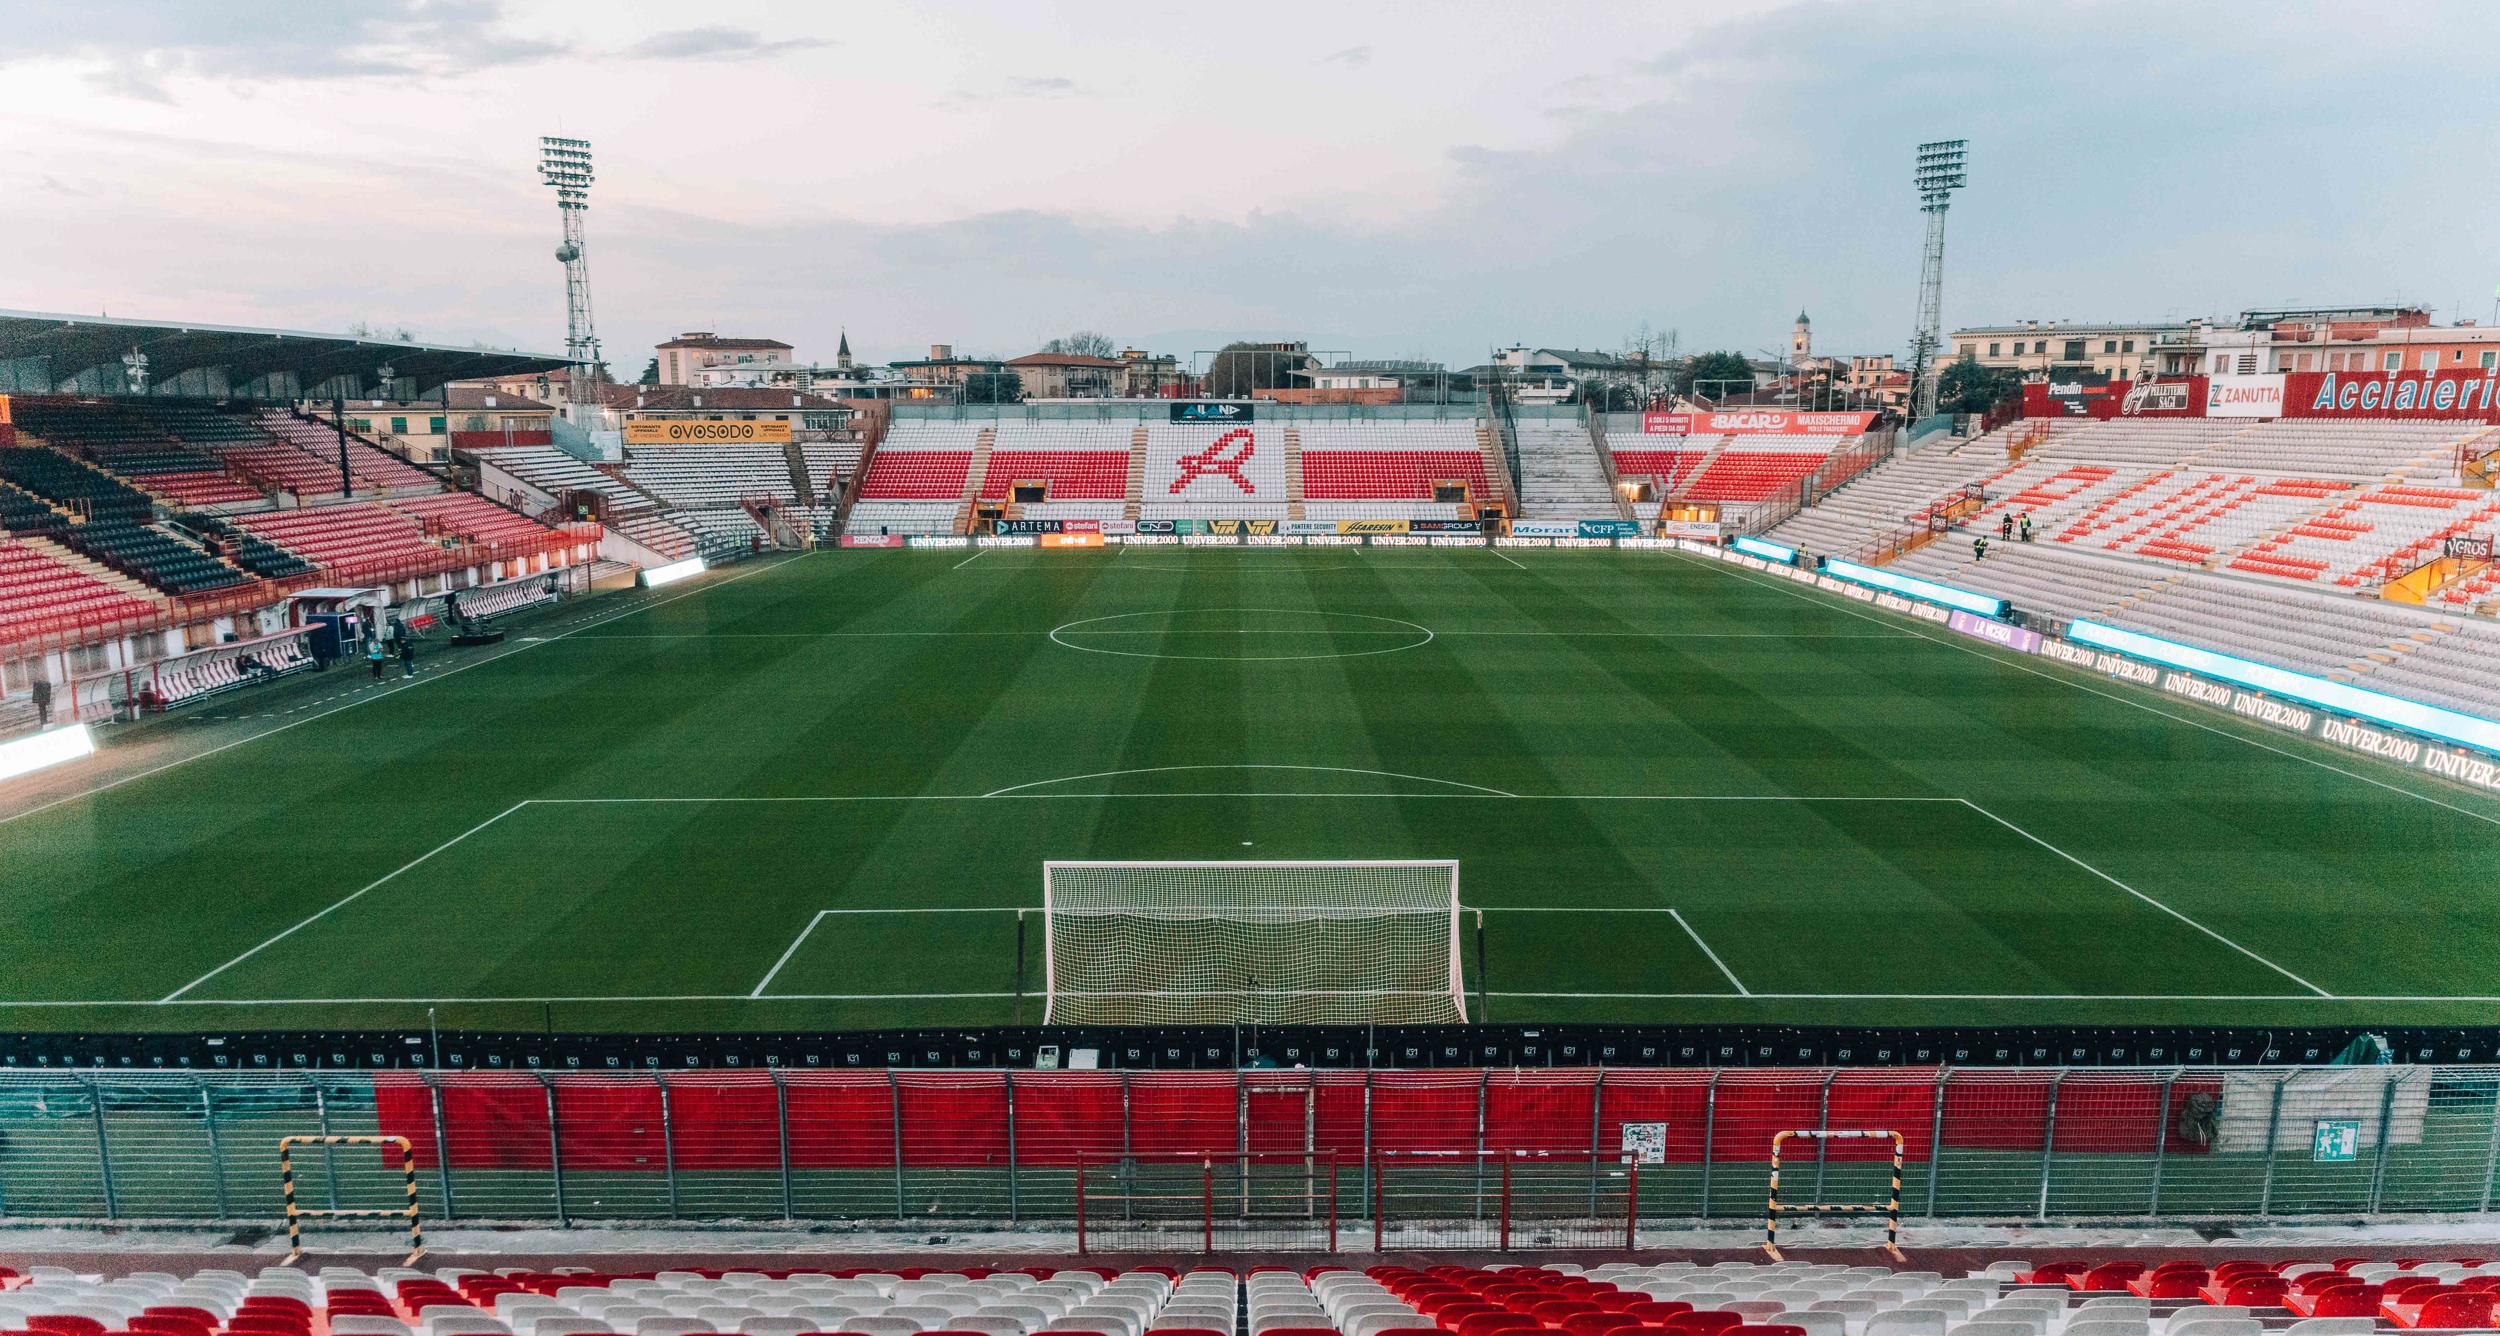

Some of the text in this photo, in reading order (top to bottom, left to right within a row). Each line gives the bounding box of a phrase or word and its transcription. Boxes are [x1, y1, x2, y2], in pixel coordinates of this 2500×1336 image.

[2048, 381, 2083, 395] Pendin
[2312, 368, 2500, 410] Acciaieri
[2158, 396, 2177, 409] SAGI
[2225, 388, 2281, 404] ZANUTTA
[1797, 415, 1861, 426] MAXISCHERMO
[669, 424, 754, 439] OVOSODO
[1011, 521, 1060, 531] ARTEMA
[1592, 525, 1614, 534] CFP
[911, 537, 1034, 546] UNIVER2000 UNIVER2000
[1123, 536, 1178, 545] UNIVER2000
[1183, 536, 1238, 545] UNIVER2000
[1247, 536, 1302, 545] UNIVER2000
[1308, 536, 1362, 545] UNIVER2000
[1372, 536, 1427, 546] UNIVER2000
[1431, 536, 1486, 546] UNIVER2000
[1496, 537, 1551, 547] UNIVER2000
[1555, 537, 1610, 547] UNIVER2000
[1620, 538, 1675, 548] UNIVER2000
[1985, 622, 2011, 643] VICENZA
[2041, 639, 2095, 667] UNIVER2000
[2097, 654, 2158, 684] UNIVER2000
[2165, 673, 2231, 706] UNIVER2000
[2234, 693, 2311, 731] UNIVER2000
[2323, 719, 2419, 763] UNIVER2000
